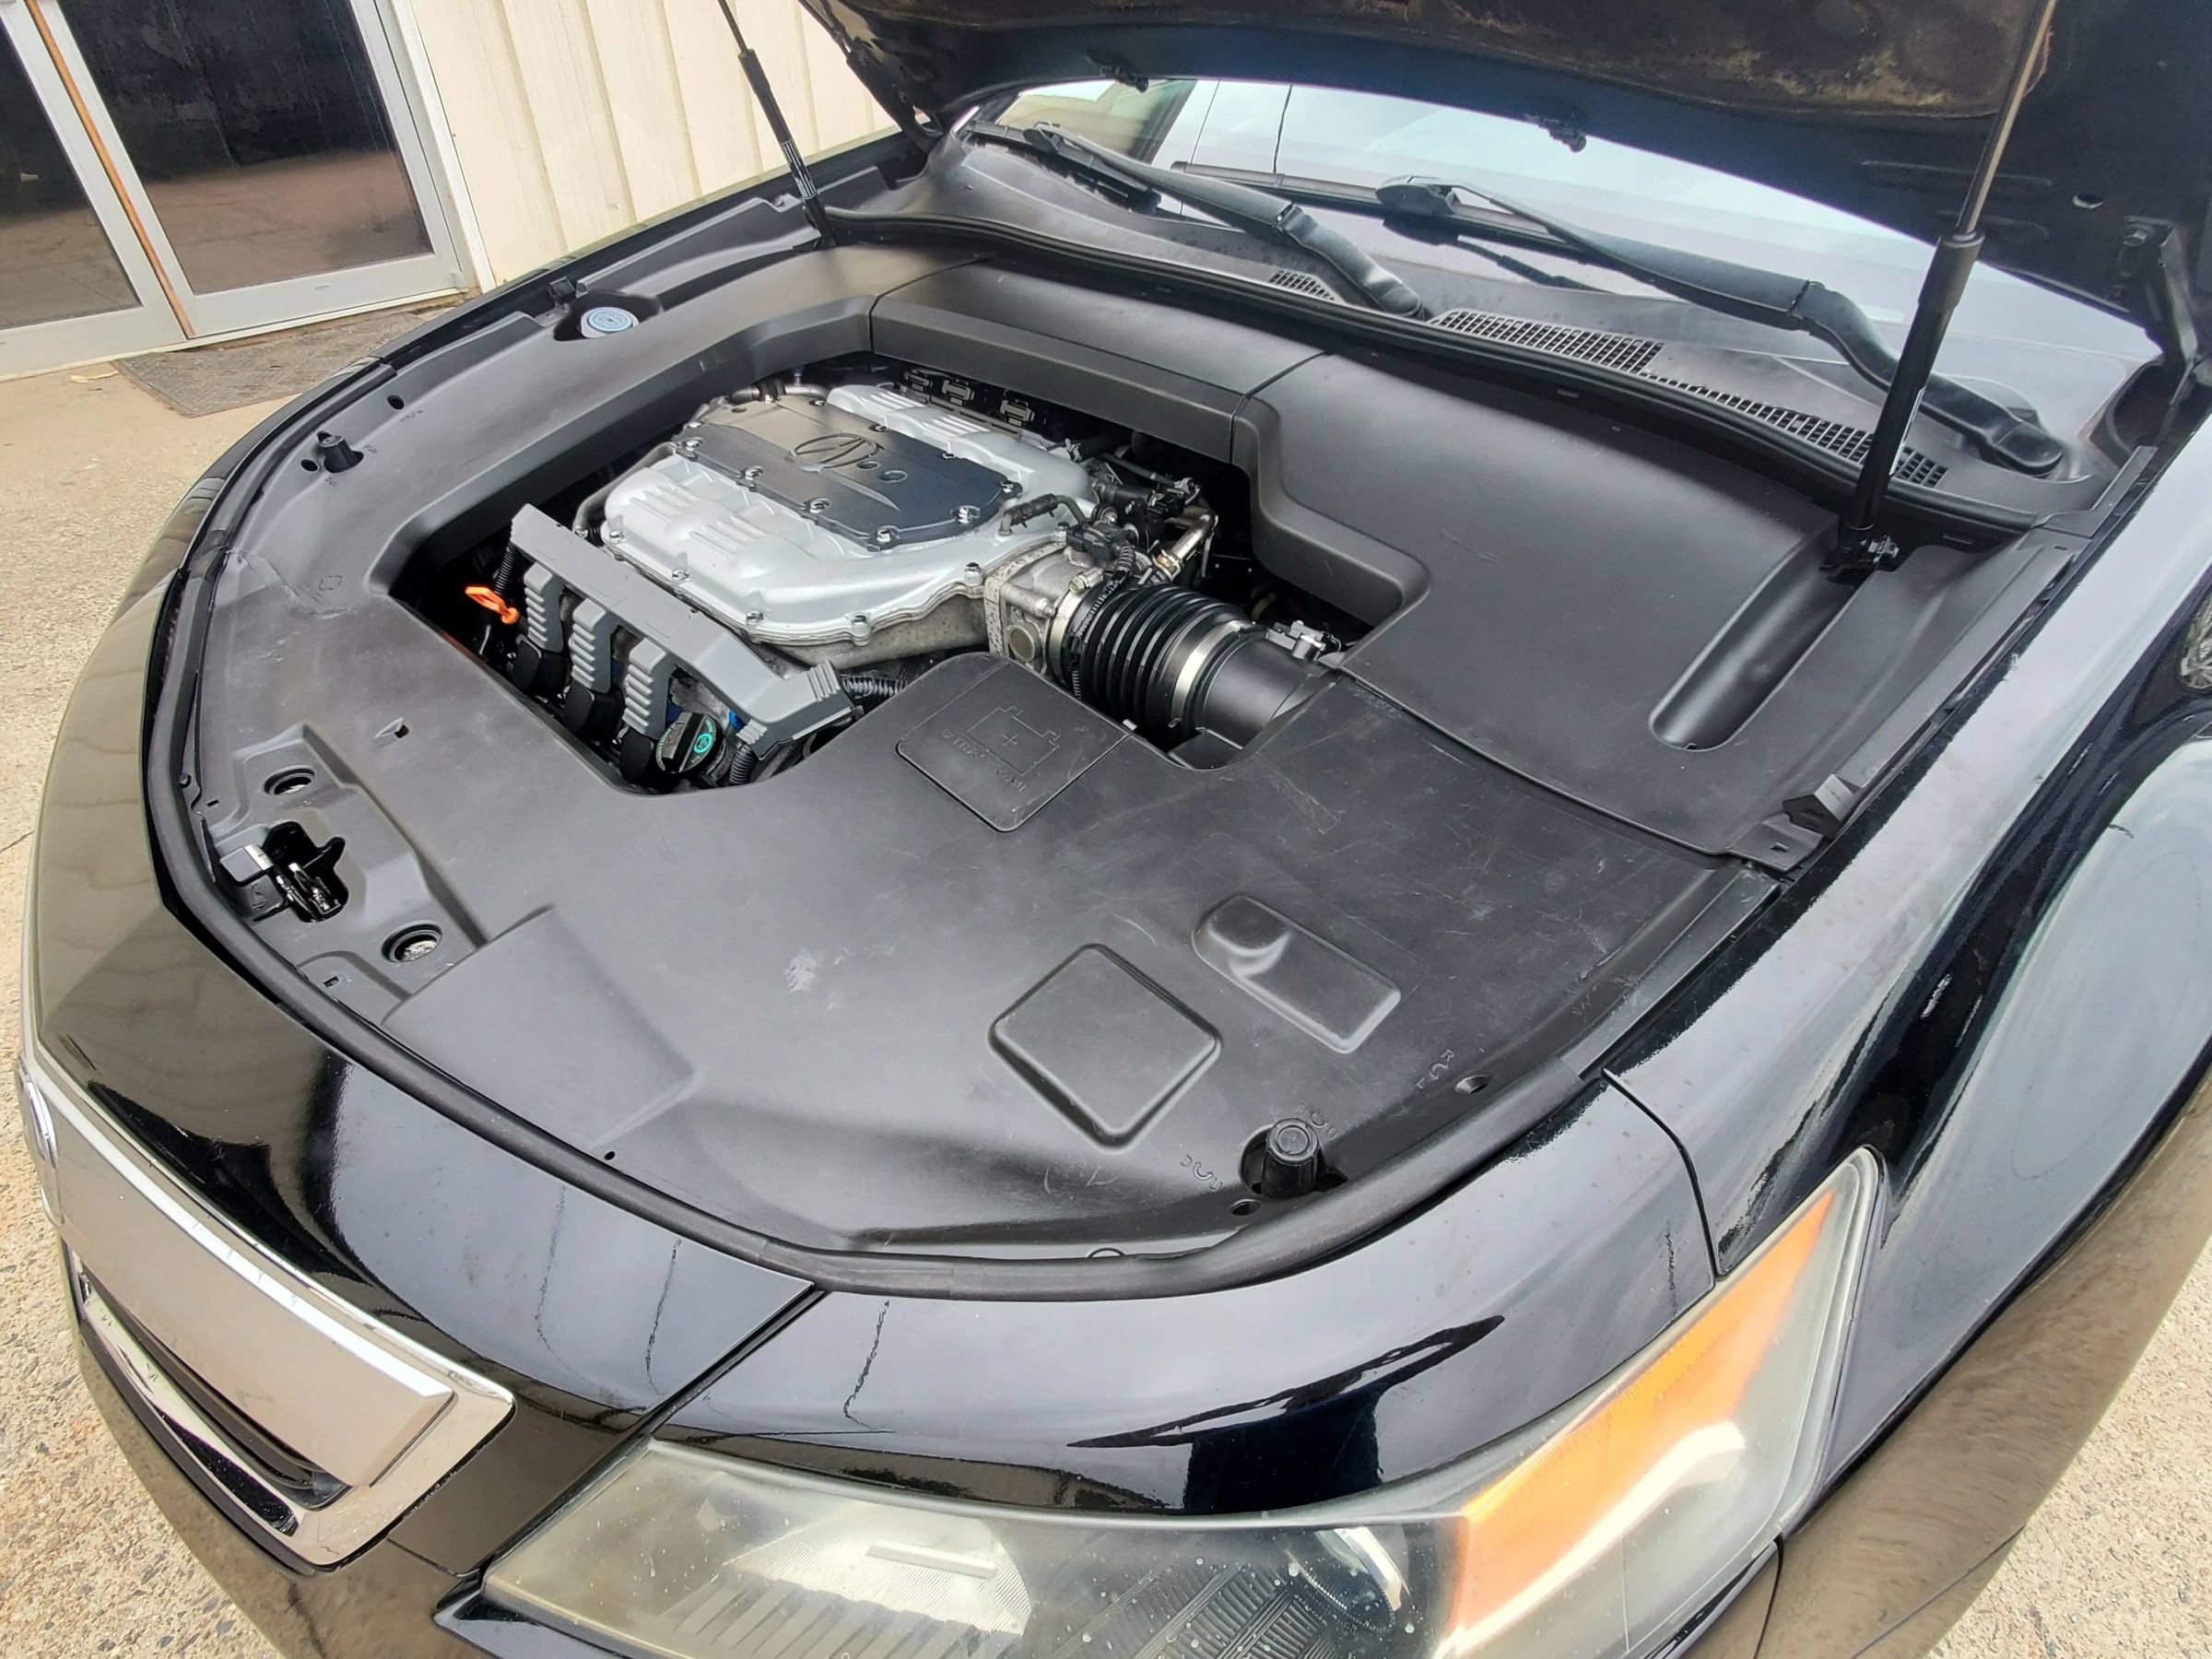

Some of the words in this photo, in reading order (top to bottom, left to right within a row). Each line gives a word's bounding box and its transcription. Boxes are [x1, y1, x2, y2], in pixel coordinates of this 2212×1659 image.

[1441, 1048, 1455, 1063] R
[1179, 1153, 1194, 1168] D
[1208, 1177, 1223, 1192] U
